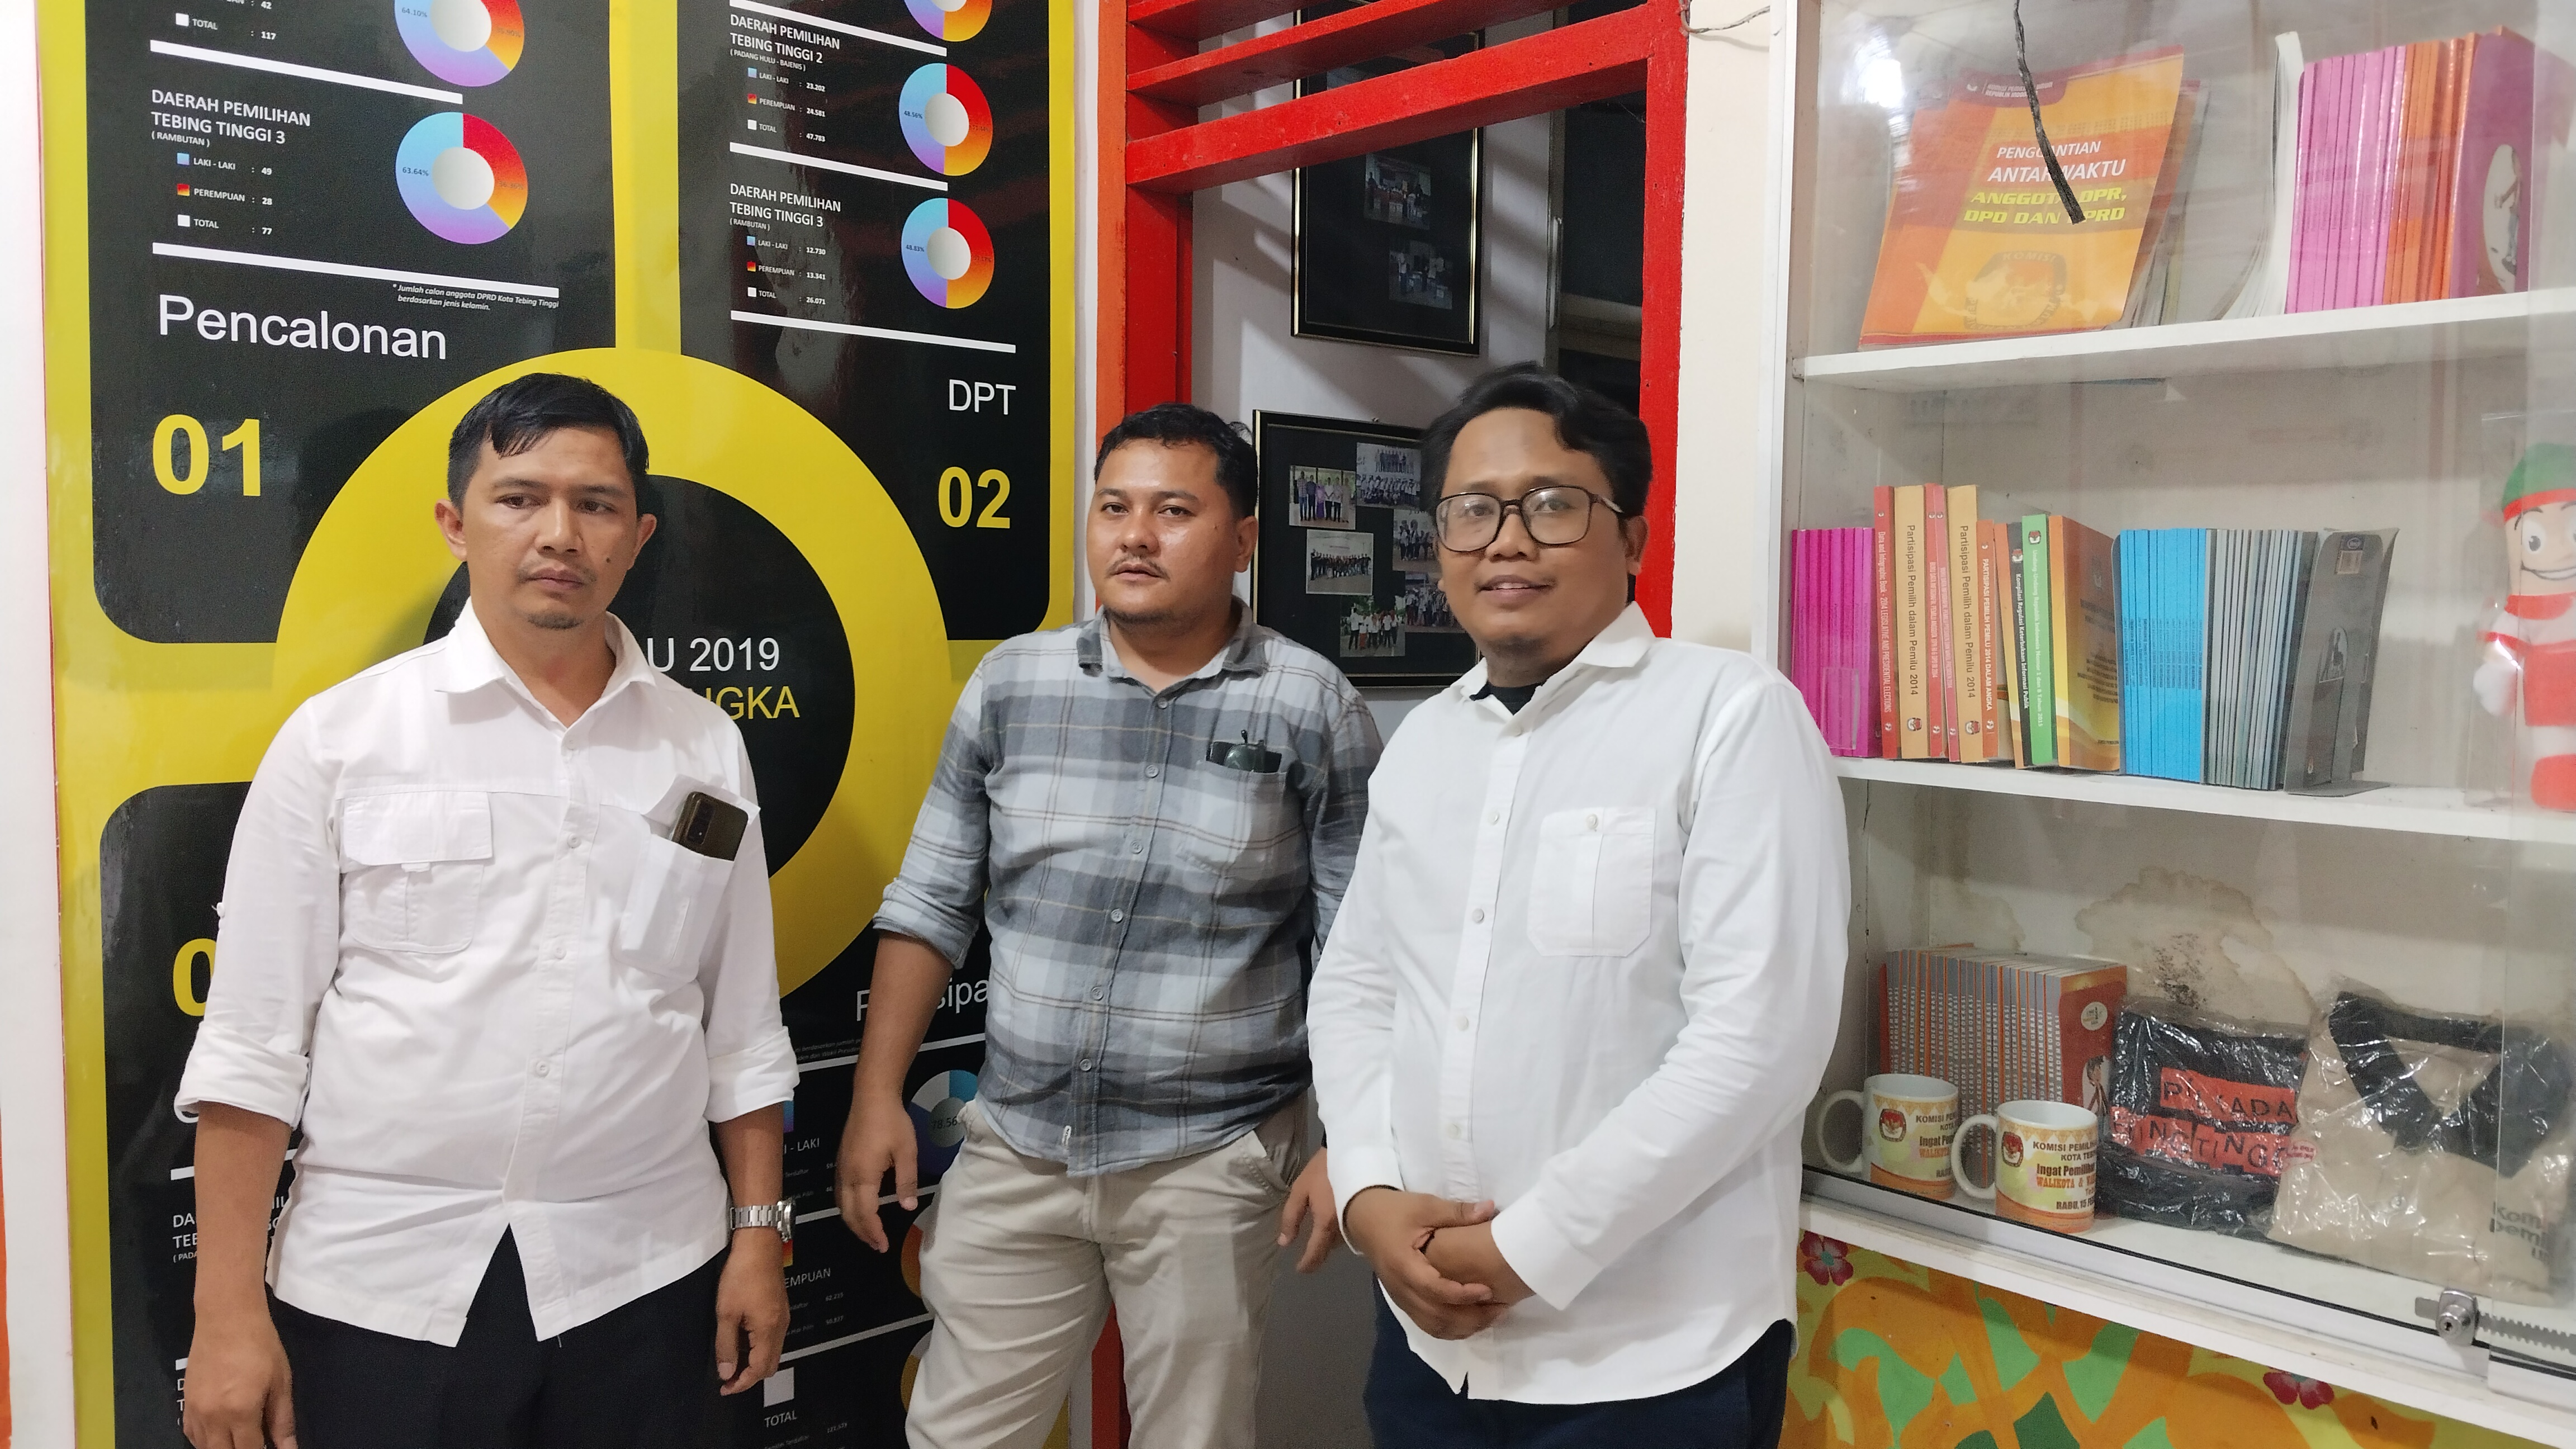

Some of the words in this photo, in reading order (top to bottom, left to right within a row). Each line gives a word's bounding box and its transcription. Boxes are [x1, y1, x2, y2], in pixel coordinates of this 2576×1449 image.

[261, 1, 272, 10] 42
[401, 7, 428, 17] 64.10%
[192, 18, 217, 30] TOTAL
[261, 31, 276, 40] 117
[731, 14, 777, 35] DAERAH
[780, 25, 840, 50] PEMILIHAN
[730, 32, 773, 51] TEBING
[775, 42, 813, 61] TINGGI
[816, 52, 823, 64] 2
[734, 50, 759, 61] PADANG
[759, 56, 775, 64] HULU
[780, 59, 803, 70] BAJENIS
[759, 72, 772, 80] LAKI
[776, 75, 789, 84] LAKI
[806, 82, 825, 92] 23.202
[152, 89, 219, 112] DAERAH
[224, 101, 310, 127] PEMILIHAN
[759, 98, 795, 111] PEREMPUAN
[806, 107, 826, 117] 24.581
[151, 112, 211, 134] TEBING
[216, 121, 272, 142] TINGGI
[276, 131, 286, 144] 3
[759, 123, 777, 133] TOTAL
[806, 133, 826, 143] 47.783
[157, 132, 205, 146] RAMBUTAN
[193, 158, 211, 167] LAKI
[218, 161, 236, 170] LAKI
[402, 167, 429, 177] 63.64%
[194, 188, 245, 202] PEREMPUAN
[730, 183, 776, 202] DAERAH
[780, 191, 841, 212] PEMILIHAN
[193, 219, 219, 229] TOTAL
[730, 201, 772, 219] TEBING
[774, 209, 813, 226] TINGGI
[816, 216, 823, 228] 3
[733, 218, 767, 230] RAMBUTAN
[1964, 210, 2007, 223] DPD
[2014, 211, 2061, 224] DAN
[2067, 207, 2125, 224] PRD
[806, 247, 826, 255] 12.730
[906, 244, 925, 252] 48.83%
[758, 265, 794, 276] PEREMPUAN
[807, 272, 826, 280] 13.341
[397, 285, 424, 293] Jumlah
[425, 288, 444, 296] calon
[446, 290, 475, 300] anggota
[476, 292, 496, 301] DPRD
[515, 296, 537, 306] Tebing
[538, 299, 559, 309] Tinggi
[397, 295, 442, 306] berdasarkan
[461, 301, 490, 310] kelamin.
[759, 290, 776, 299] TOTAL
[806, 297, 826, 305] 26.071
[159, 294, 446, 359] Pencalonan
[949, 378, 1016, 415] DPT
[153, 414, 261, 497] 01
[938, 466, 1010, 529] 02
[1905, 525, 1916, 572] Partisipasi
[1959, 525, 1970, 574] Partisipasi
[1878, 553, 1887, 580] Infographic
[1879, 580, 1888, 593] Book
[1907, 575, 1916, 608] Pemilih
[1962, 576, 1972, 609] Pemilih
[1880, 597, 1888, 609] 2014
[1881, 609, 1889, 640] LEGISLATIVE
[1908, 610, 1917, 637] dalam
[2016, 602, 2024, 626] Regulasi
[1963, 612, 1973, 639] dalam
[690, 637, 779, 671] 2019
[1909, 640, 1917, 670] Pemilu
[1965, 642, 1974, 673] Pemilu
[1882, 651, 1891, 686] PRESIDENTIAL
[1910, 674, 1918, 695] 2014
[1967, 676, 1976, 698] 2014
[1883, 686, 1892, 713] ELECTIONS
[1916, 1114, 1944, 1123] KOMISI
[797, 1137, 820, 1152] LAKI
[1919, 1135, 1941, 1148] Ingat
[2033, 1141, 2066, 1152] KOMISI
[2037, 1163, 2062, 1177] Ingat
[2037, 1176, 2075, 1188] WALIKOTA
[764, 1410, 797, 1428] TOTAL
